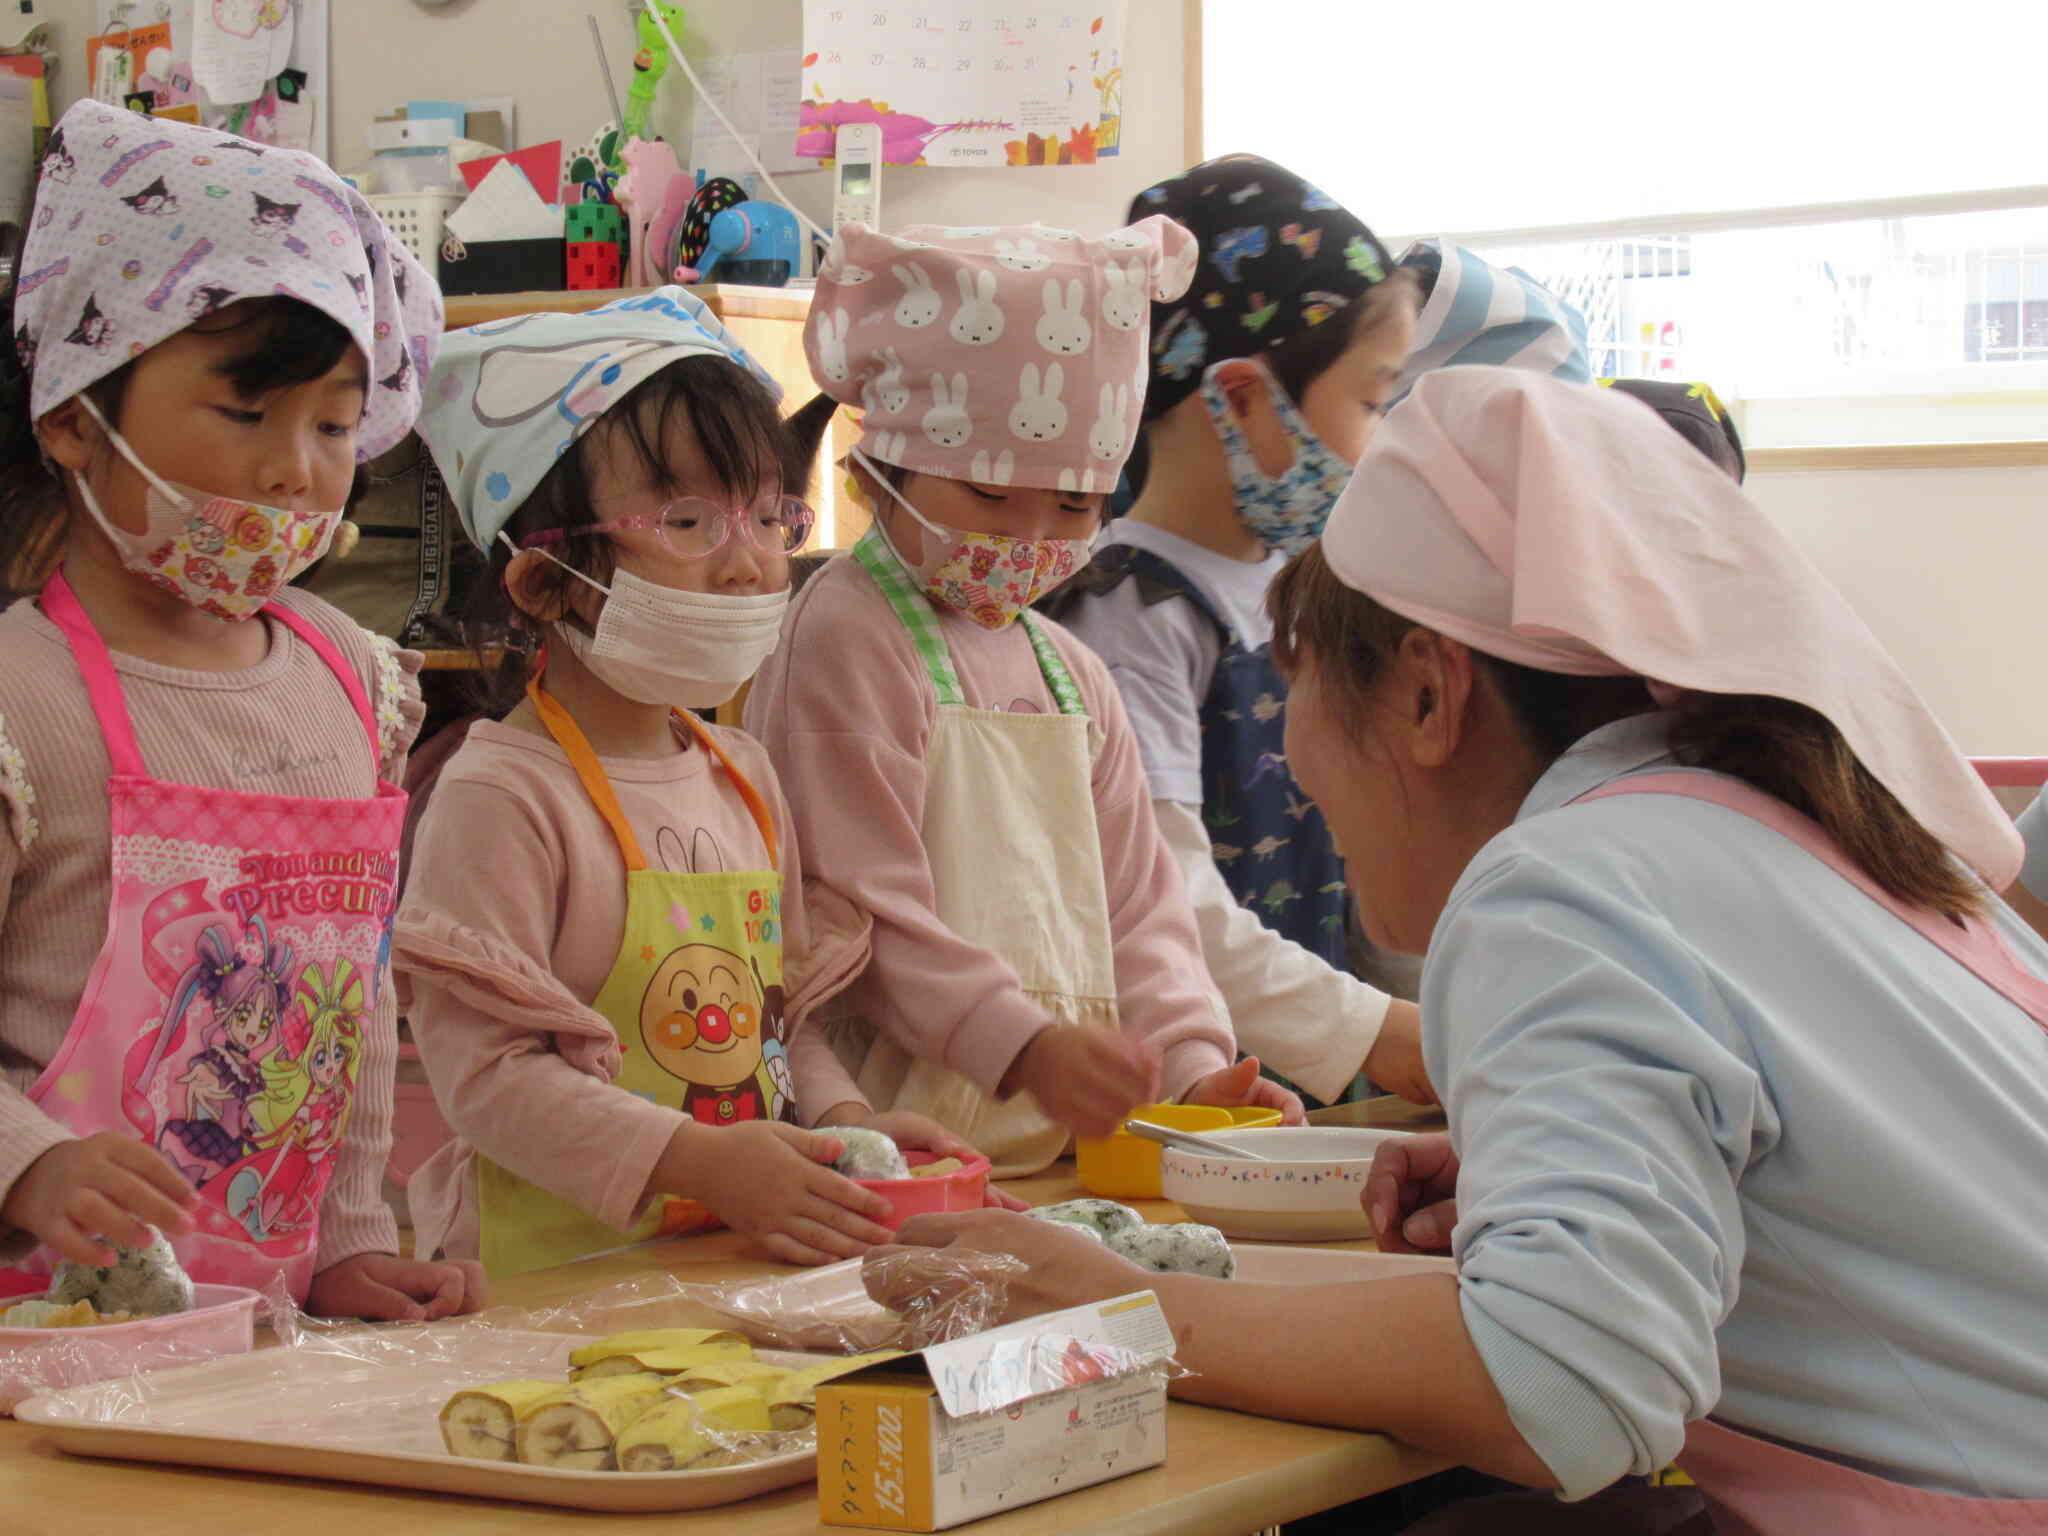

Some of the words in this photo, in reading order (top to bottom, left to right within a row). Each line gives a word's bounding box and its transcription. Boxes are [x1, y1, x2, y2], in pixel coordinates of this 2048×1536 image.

[829, 11, 843, 24] 19
[872, 14, 887, 27] 20
[914, 17, 928, 29] 21
[913, 57, 927, 70] 28
[957, 57, 971, 71] 29
[425, 491, 439, 545] GOALS
[309, 852, 364, 876] and
